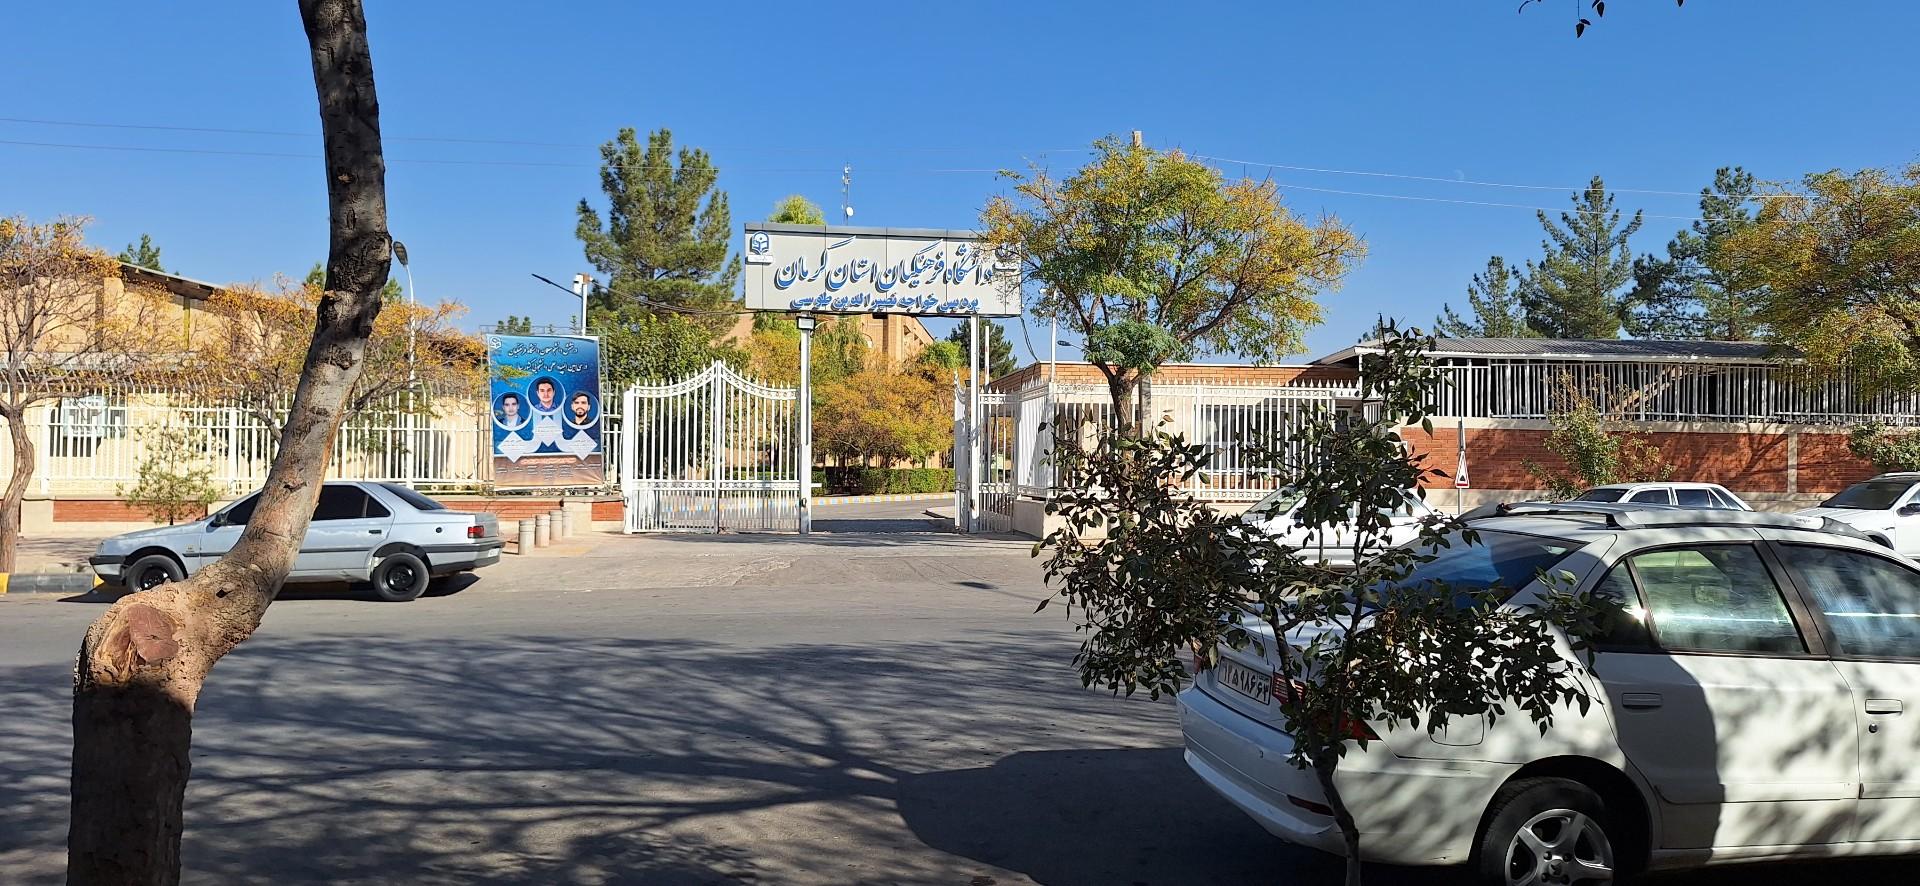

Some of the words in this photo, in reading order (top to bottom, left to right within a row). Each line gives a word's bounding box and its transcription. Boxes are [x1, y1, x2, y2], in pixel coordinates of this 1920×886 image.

[775, 236, 856, 289] کرمان
[875, 239, 945, 292] فرهنگیان
[943, 243, 993, 285] دانشگاه
[826, 257, 877, 291] استان
[790, 293, 832, 311] طوسی
[831, 293, 870, 311] الدین
[868, 293, 896, 312] نصیر
[897, 293, 939, 313] خواجه
[937, 297, 979, 313] پردیس
